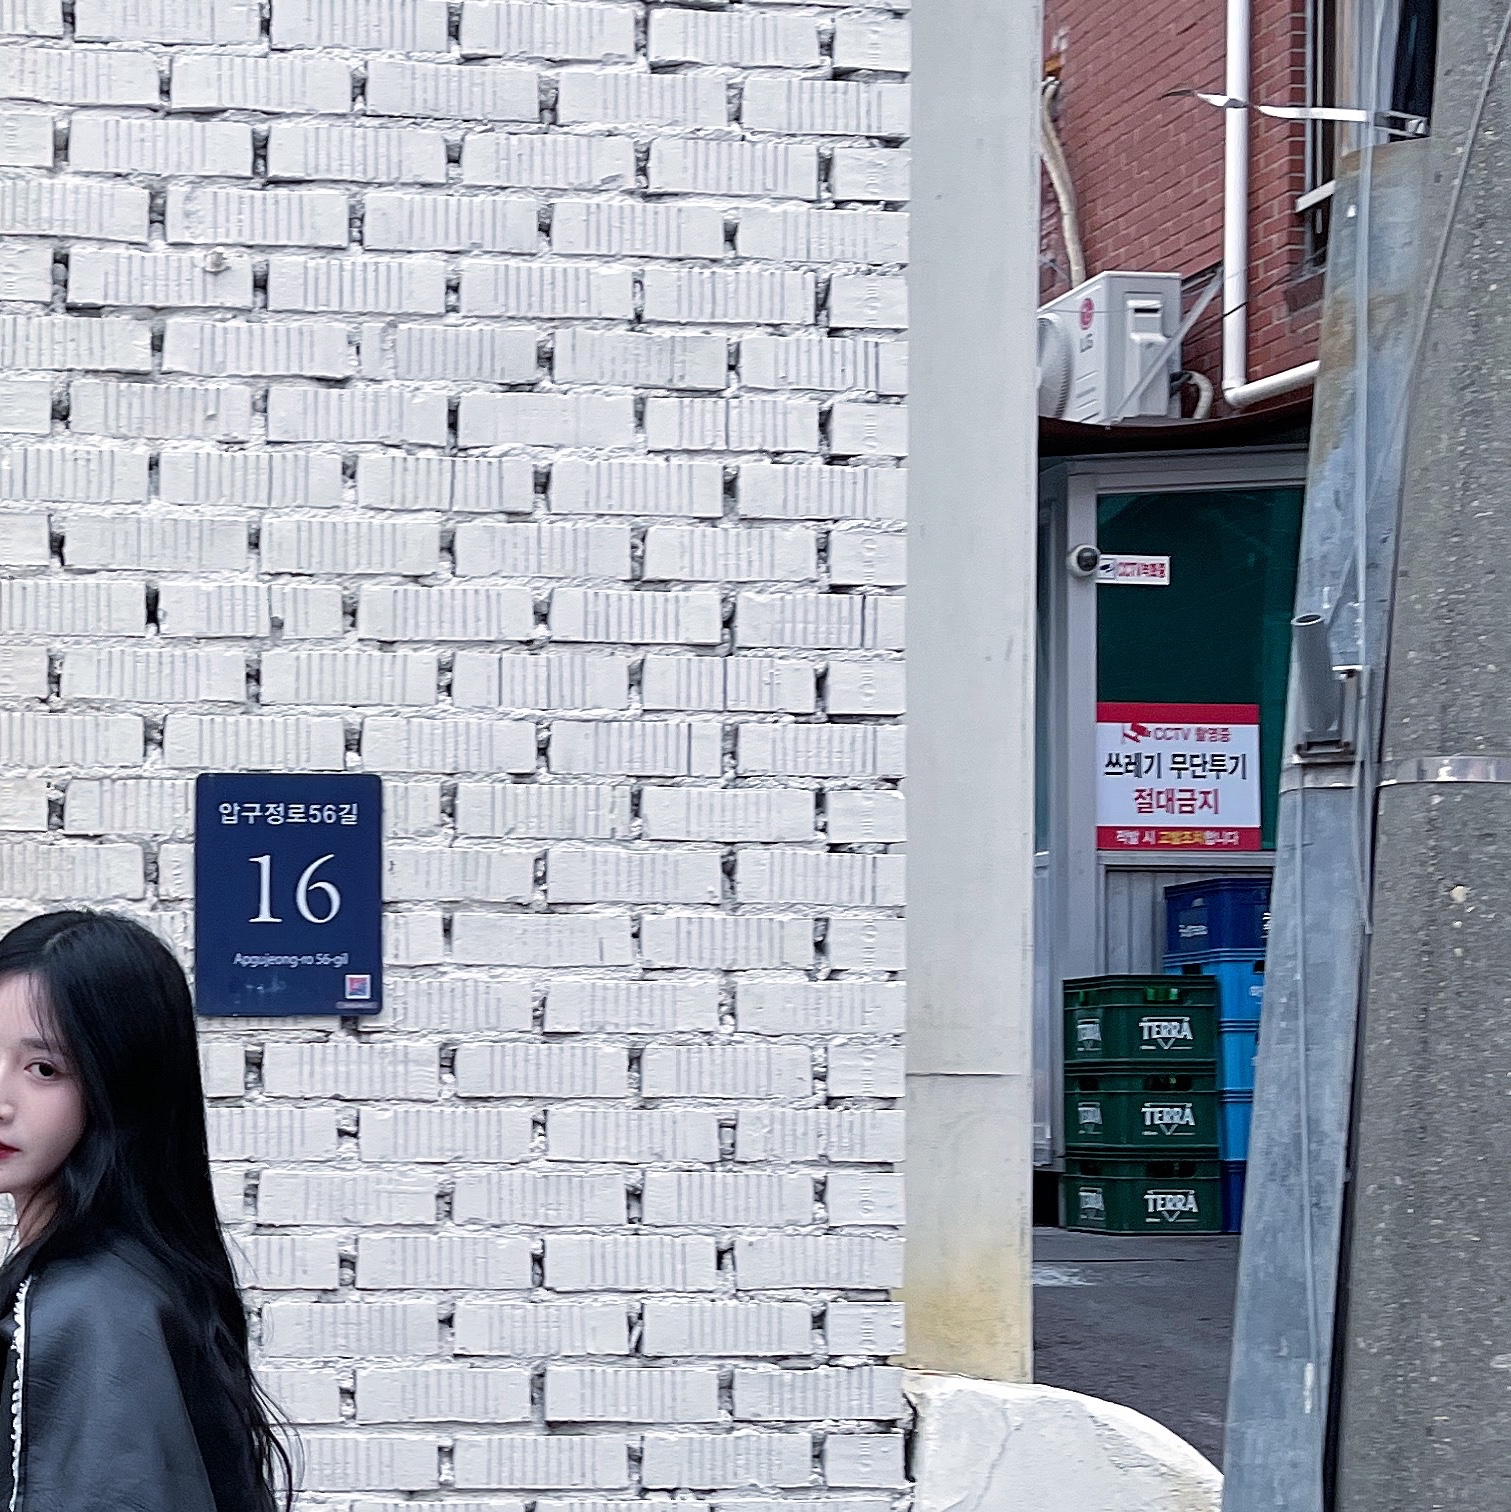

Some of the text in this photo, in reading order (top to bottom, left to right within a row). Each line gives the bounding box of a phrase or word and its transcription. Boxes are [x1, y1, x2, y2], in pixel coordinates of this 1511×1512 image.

[1153, 727, 1192, 741] CCTV
[1104, 752, 1247, 780] 쓰레기 무단투기
[1134, 788, 1219, 815] 절대금지
[219, 803, 358, 825] 압구정로56길
[248, 854, 341, 924] 16
[233, 952, 349, 968] Apgujeong-ro 56-gil
[1138, 1020, 1193, 1040] TERRA
[1141, 1107, 1196, 1126] TERRA
[1143, 1194, 1199, 1213] TERRA
